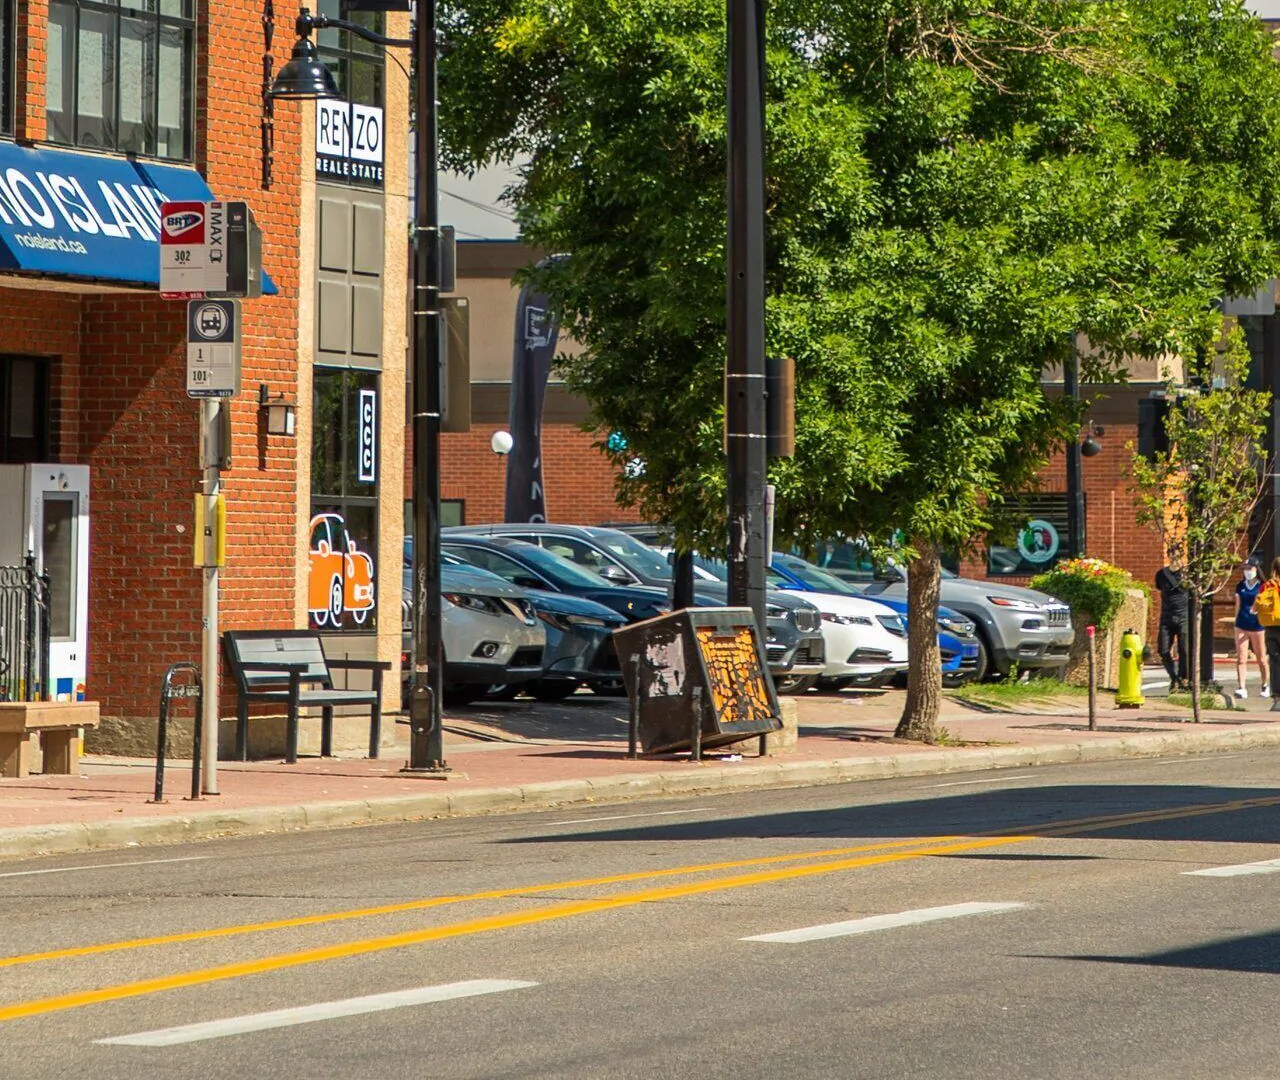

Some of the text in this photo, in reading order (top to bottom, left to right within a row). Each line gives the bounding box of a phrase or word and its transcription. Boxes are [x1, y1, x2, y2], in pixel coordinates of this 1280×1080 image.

[321, 107, 379, 157] RENZO
[36, 172, 171, 242] ISLAN
[167, 216, 190, 226] BRT
[210, 212, 222, 245] MAX
[15, 233, 88, 255] noisland.ca
[175, 250, 191, 262] 302
[198, 348, 203, 359] 1
[193, 370, 207, 381] 101
[363, 403, 372, 469] CCC
